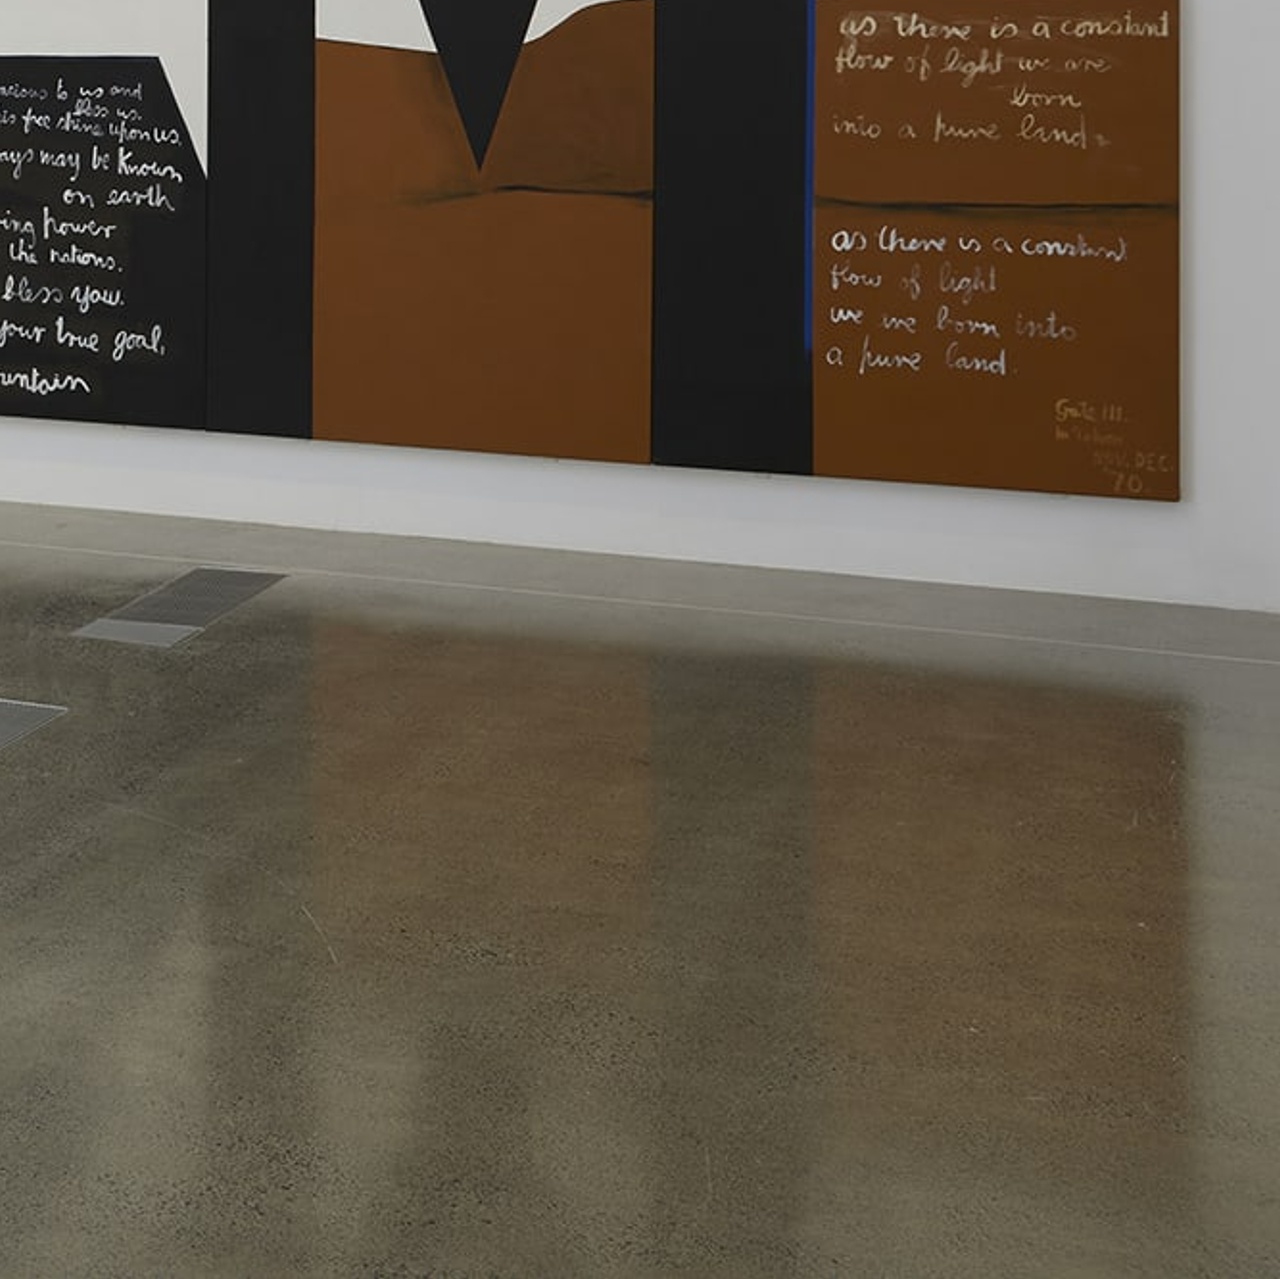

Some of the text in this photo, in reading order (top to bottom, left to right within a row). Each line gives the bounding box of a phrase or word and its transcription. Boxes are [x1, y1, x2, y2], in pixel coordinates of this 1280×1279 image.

[839, 10, 1169, 40] as there is a constant
[835, 43, 894, 74] flow
[904, 43, 931, 82] of
[939, 46, 1004, 88] light
[1018, 56, 1050, 72] we
[56, 77, 68, 101] to
[79, 86, 105, 99] us
[110, 82, 143, 102] and
[72, 97, 109, 117] bless
[1009, 82, 1082, 108] born
[21, 106, 51, 135] face
[56, 111, 104, 137] shine
[108, 120, 151, 144] upon
[833, 114, 881, 139] into
[897, 123, 918, 139] a
[933, 109, 1003, 143] pure
[40, 148, 80, 182] may
[92, 144, 110, 171] be
[62, 183, 176, 212] on earth
[43, 206, 118, 240] power
[9, 237, 38, 265] the
[49, 243, 123, 273] nations.
[830, 225, 1127, 263] as there is a constant
[2, 273, 64, 305] bless
[829, 259, 997, 306] flow of light
[55, 315, 100, 352] true
[111, 323, 167, 362] goal,
[830, 306, 864, 324] we
[935, 304, 1002, 340] born
[1016, 309, 1079, 342] into
[826, 346, 845, 367] a
[858, 333, 923, 376] pure
